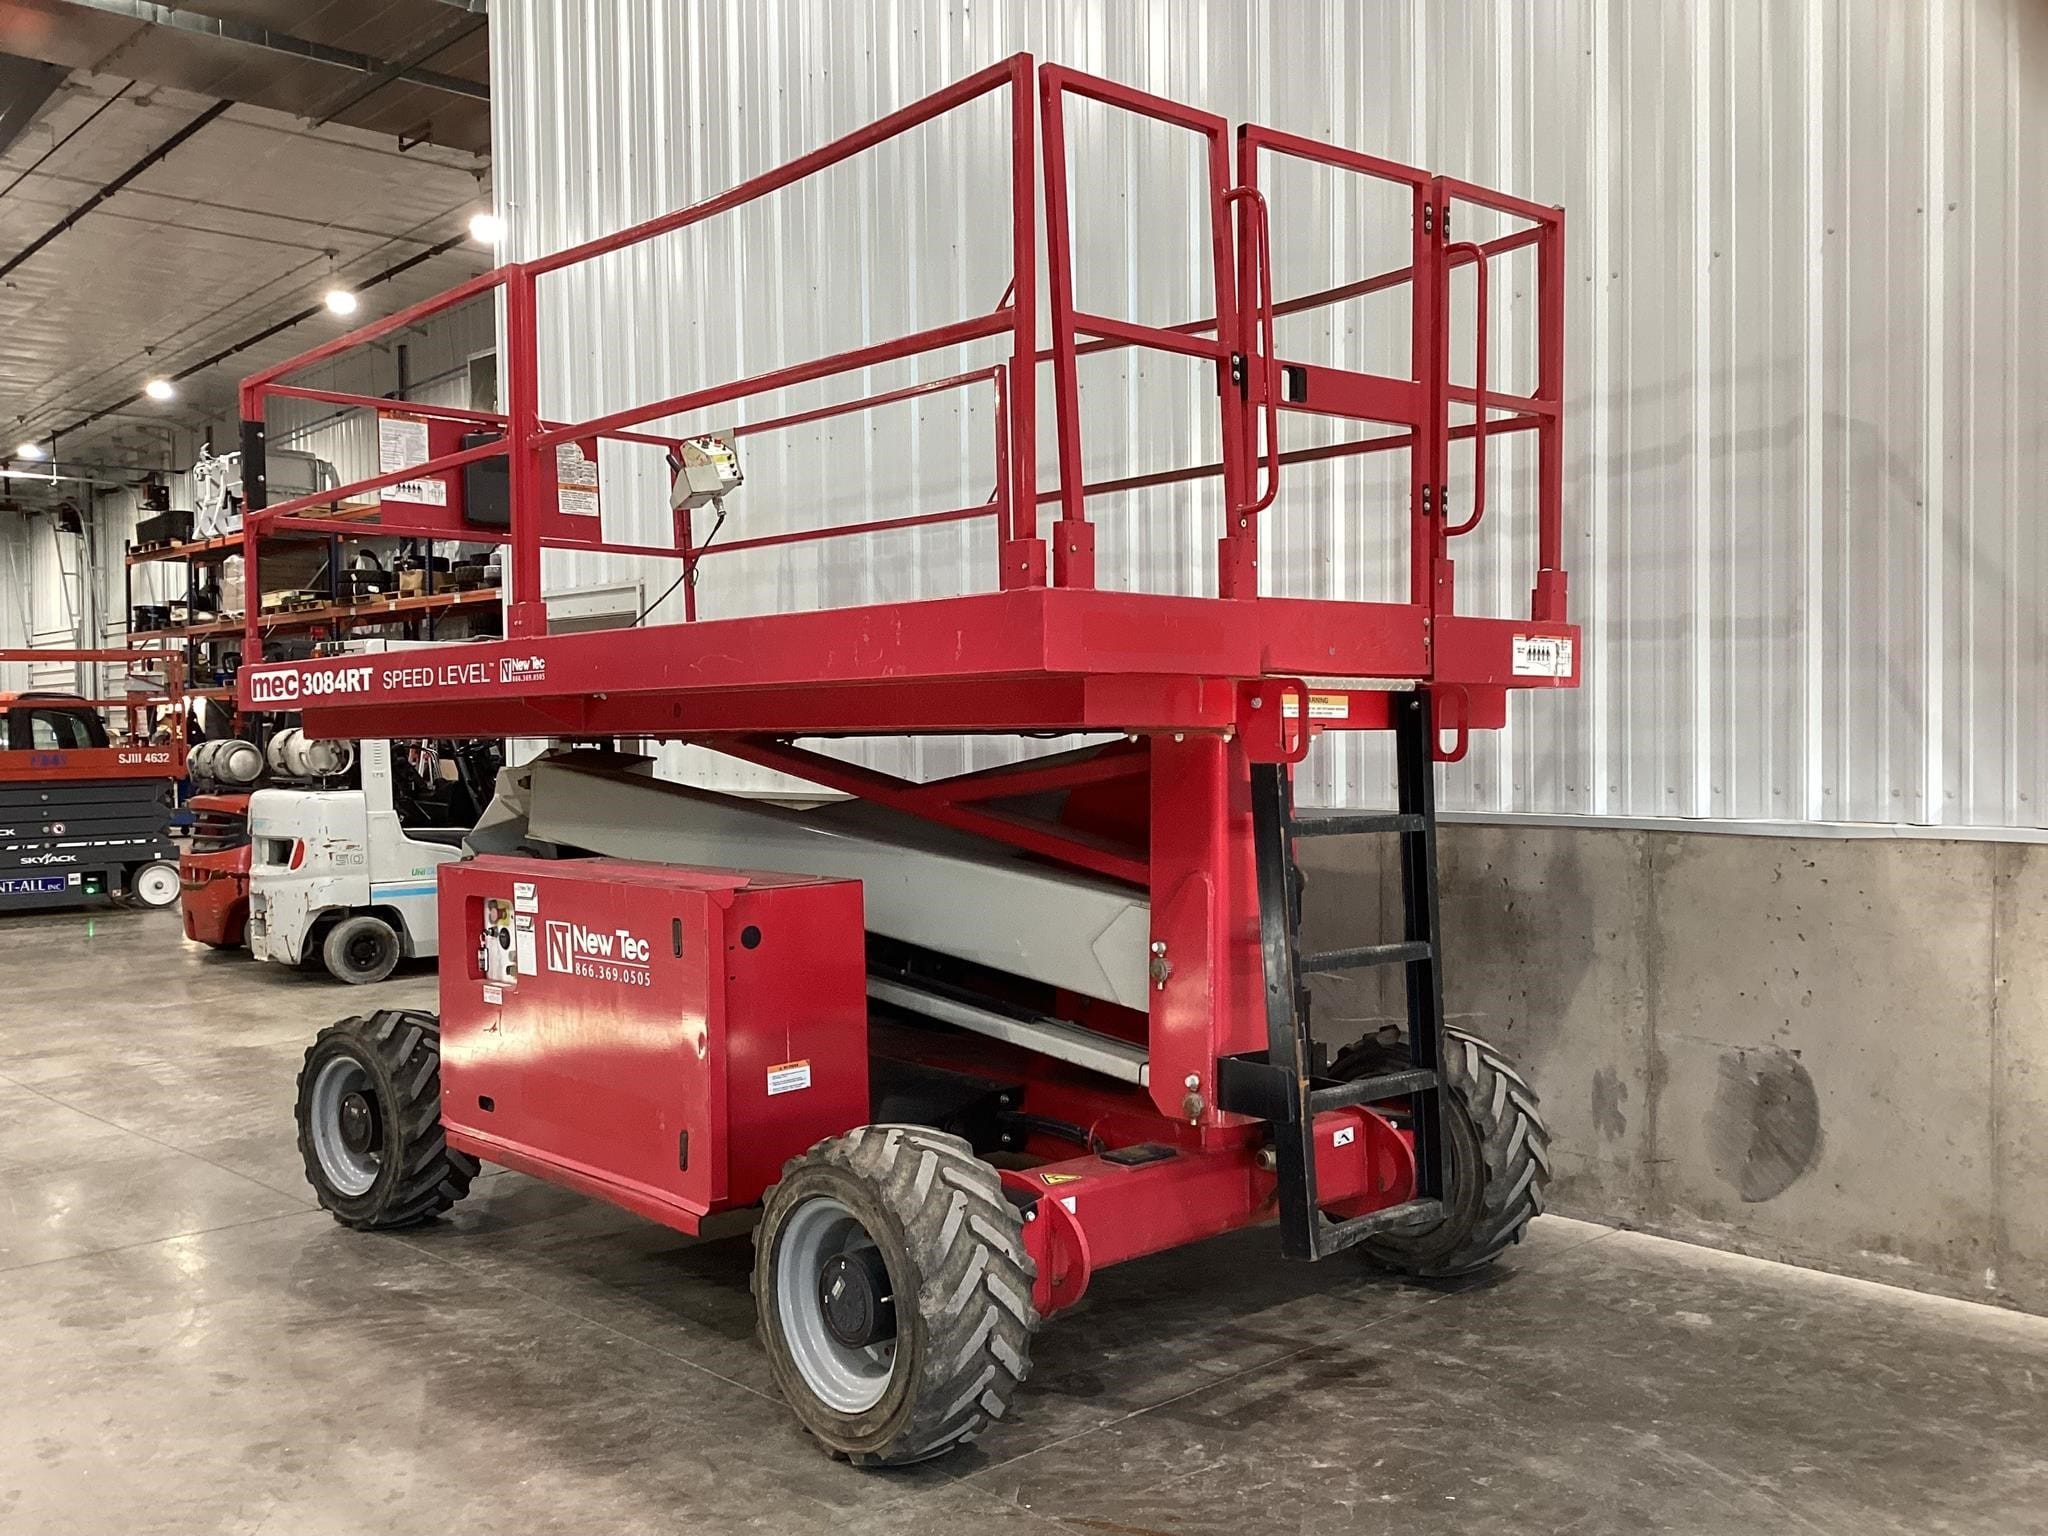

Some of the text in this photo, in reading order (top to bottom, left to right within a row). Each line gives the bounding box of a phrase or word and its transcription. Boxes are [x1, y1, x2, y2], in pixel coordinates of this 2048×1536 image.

[512, 655, 545, 671] New Tec
[252, 672, 298, 699] mec
[301, 667, 374, 696] 3084RT
[382, 667, 434, 690] SPEED
[118, 752, 170, 764] SJIII 4632
[20, 852, 78, 865] SKYJACK
[572, 923, 614, 956] New
[615, 929, 650, 962] Tec
[574, 961, 651, 987] 866.369.0505
